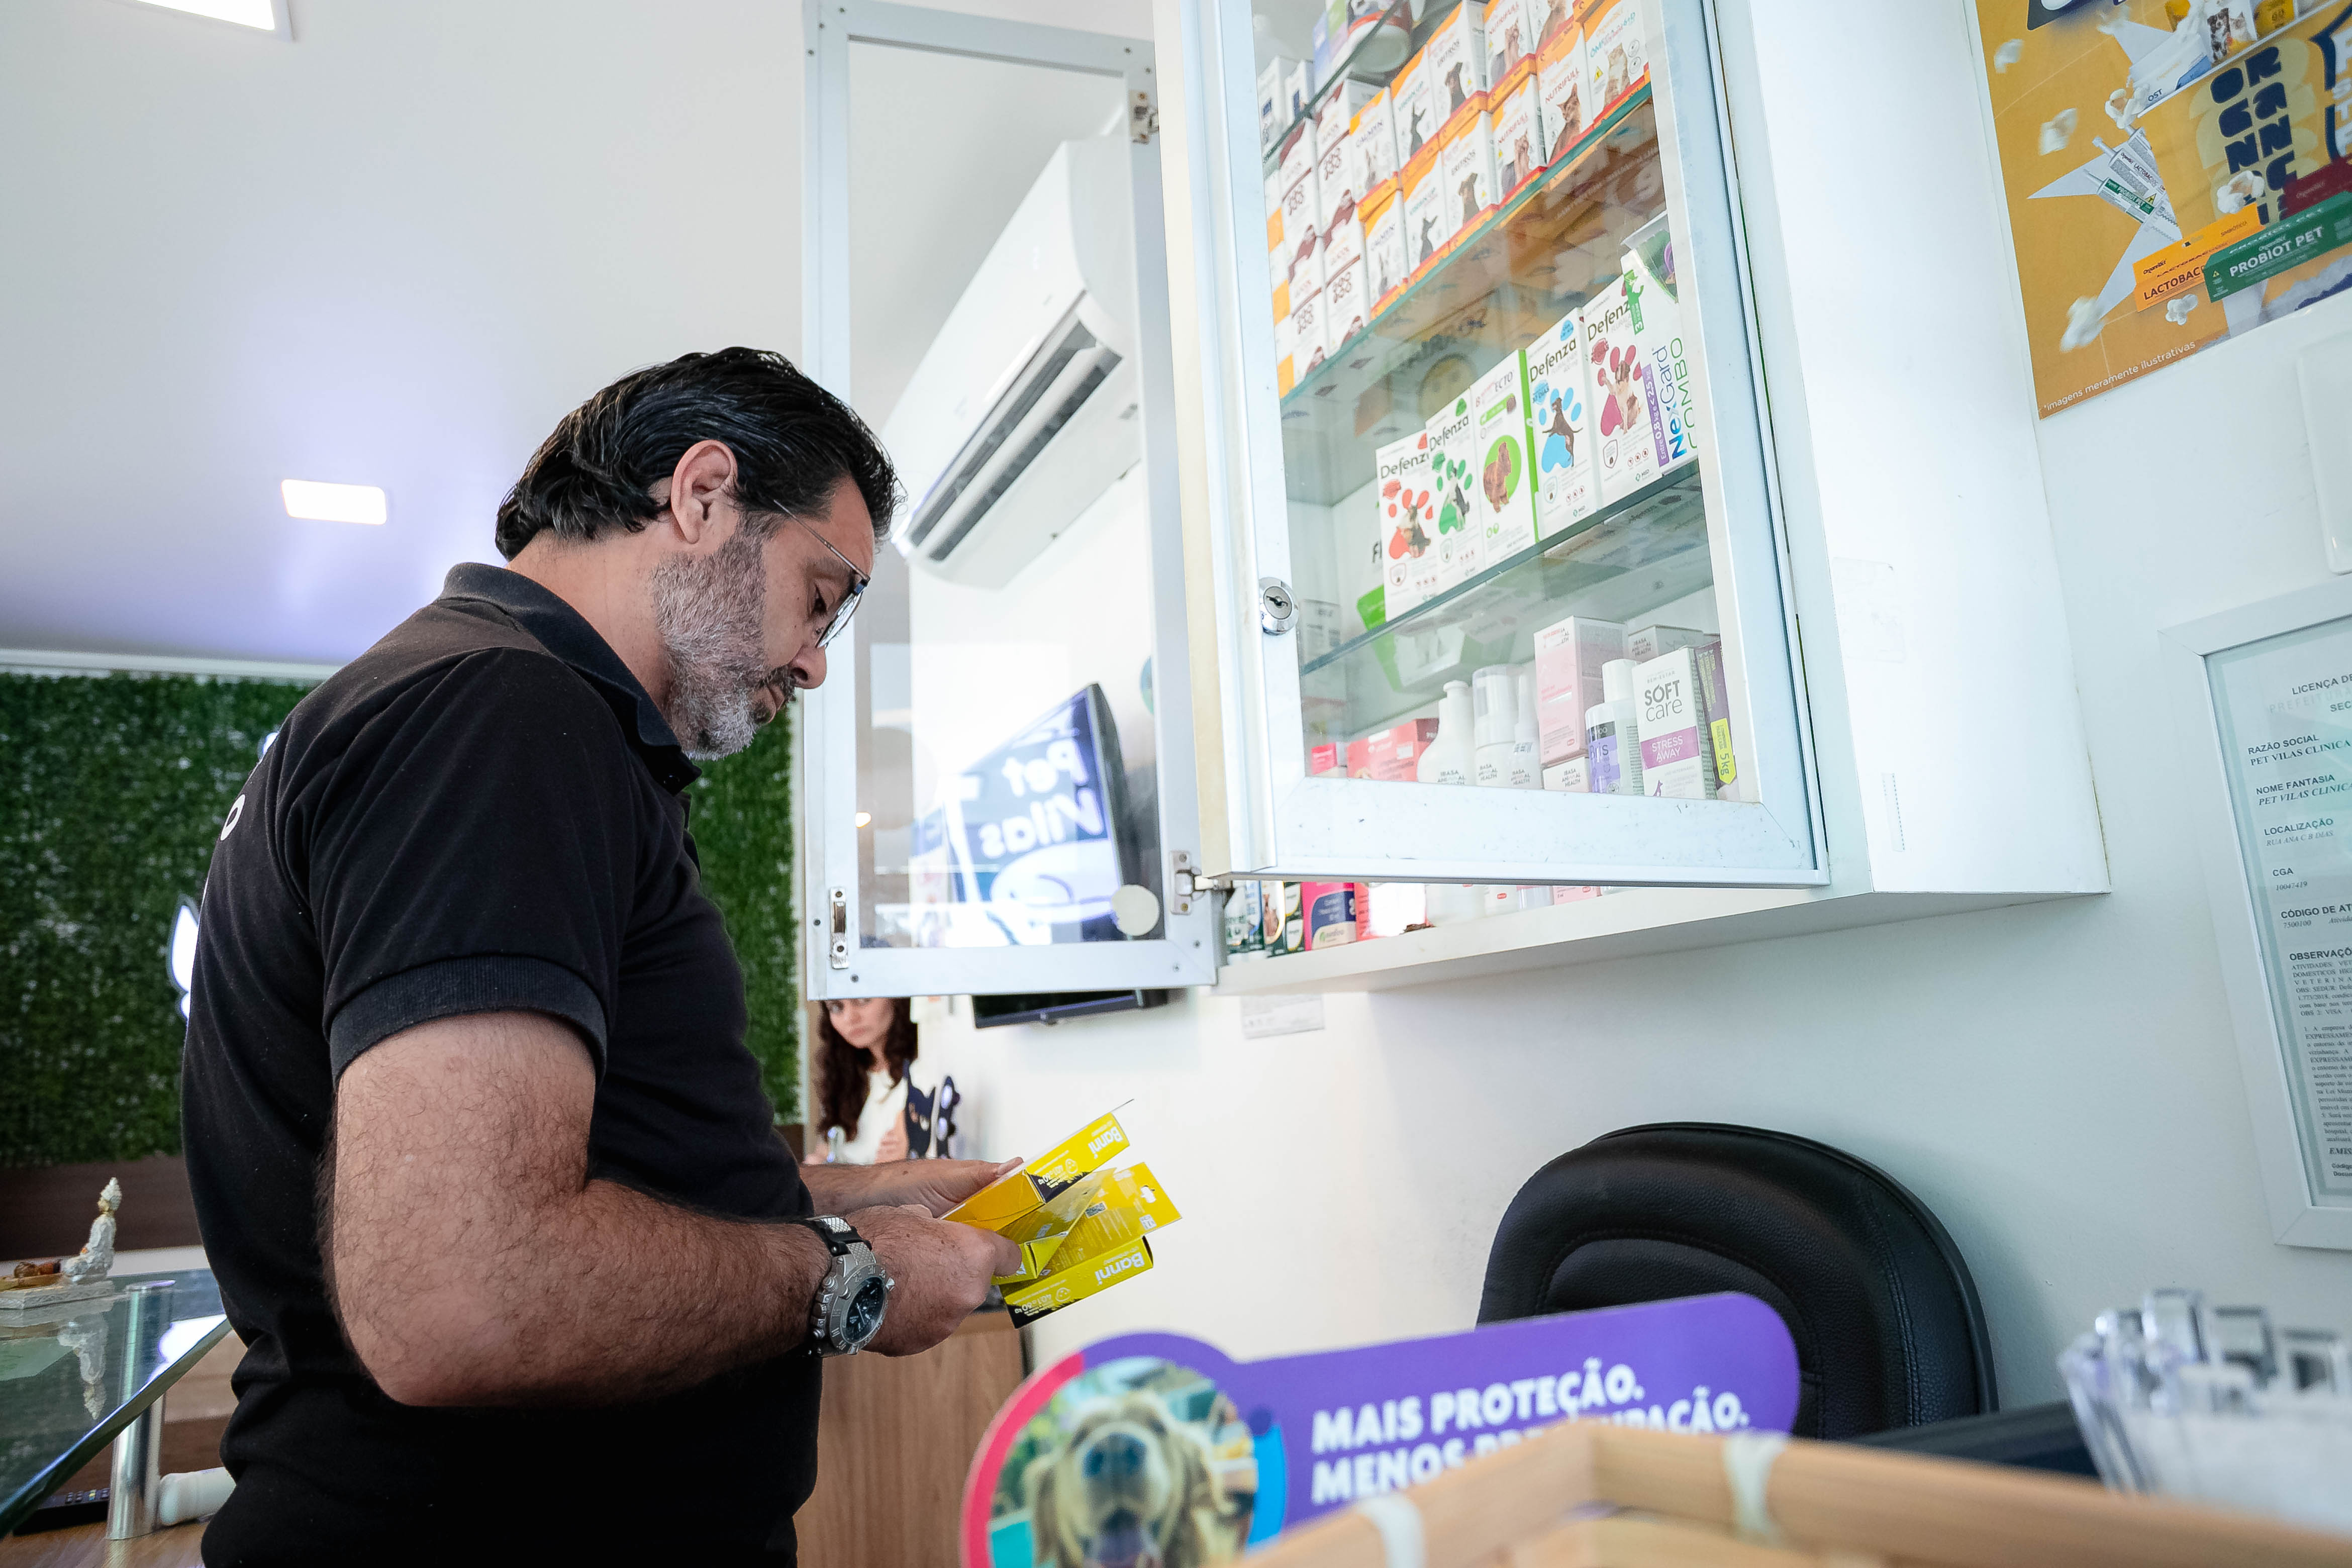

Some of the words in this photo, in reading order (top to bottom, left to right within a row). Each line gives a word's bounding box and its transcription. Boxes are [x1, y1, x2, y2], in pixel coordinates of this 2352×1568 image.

[2117, 185, 2137, 202] PROBIOT
[2136, 198, 2144, 207] PET
[2229, 240, 2291, 277] PROBIOT
[2296, 226, 2323, 247] PET
[2143, 266, 2201, 301] LACTOBAC
[1588, 300, 1630, 342] Defenz
[1530, 337, 1577, 382] Defenza
[2085, 365, 2138, 393] meramente
[2140, 341, 2196, 370] ilustrativas
[1430, 416, 1469, 451] Defenza
[1658, 439, 1668, 460] Entre
[1380, 452, 1429, 479] Defenz
[1644, 679, 1680, 706] SOFT
[2292, 678, 2338, 695] LICENÇA
[1646, 699, 1683, 722] care
[2330, 701, 2352, 712] SEC
[1652, 735, 1683, 753] STRESS
[1656, 747, 1681, 763] AWAY
[2248, 741, 2281, 755] RAZÃO
[2283, 734, 2319, 748] SOCIAL
[2250, 755, 2270, 766] PET
[2272, 749, 2303, 761] VILAS
[2305, 739, 2351, 754] CLINICA
[2256, 783, 2284, 795] NOME
[2286, 774, 2335, 789] FANTASIA
[2259, 795, 2277, 806] PET
[2280, 790, 2309, 802] VILAS
[2311, 782, 2352, 796] CLINICA
[2264, 818, 2333, 836] LOCALIZAÇÃO
[2267, 839, 2282, 847] RUA
[2284, 836, 2299, 844] ANA
[2315, 830, 2334, 839] DIAS
[2272, 867, 2294, 876] CGA
[2281, 907, 2320, 919] CÓDIGO
[2322, 905, 2336, 914] DE
[2339, 903, 2352, 912] AT
[1087, 1125, 1125, 1160] Banni
[1094, 1251, 1146, 1286] Banni
[1310, 1395, 1425, 1456] MAIS
[1430, 1355, 1646, 1437] PROTEÇÃO.
[1310, 1437, 1466, 1505] MENOS
